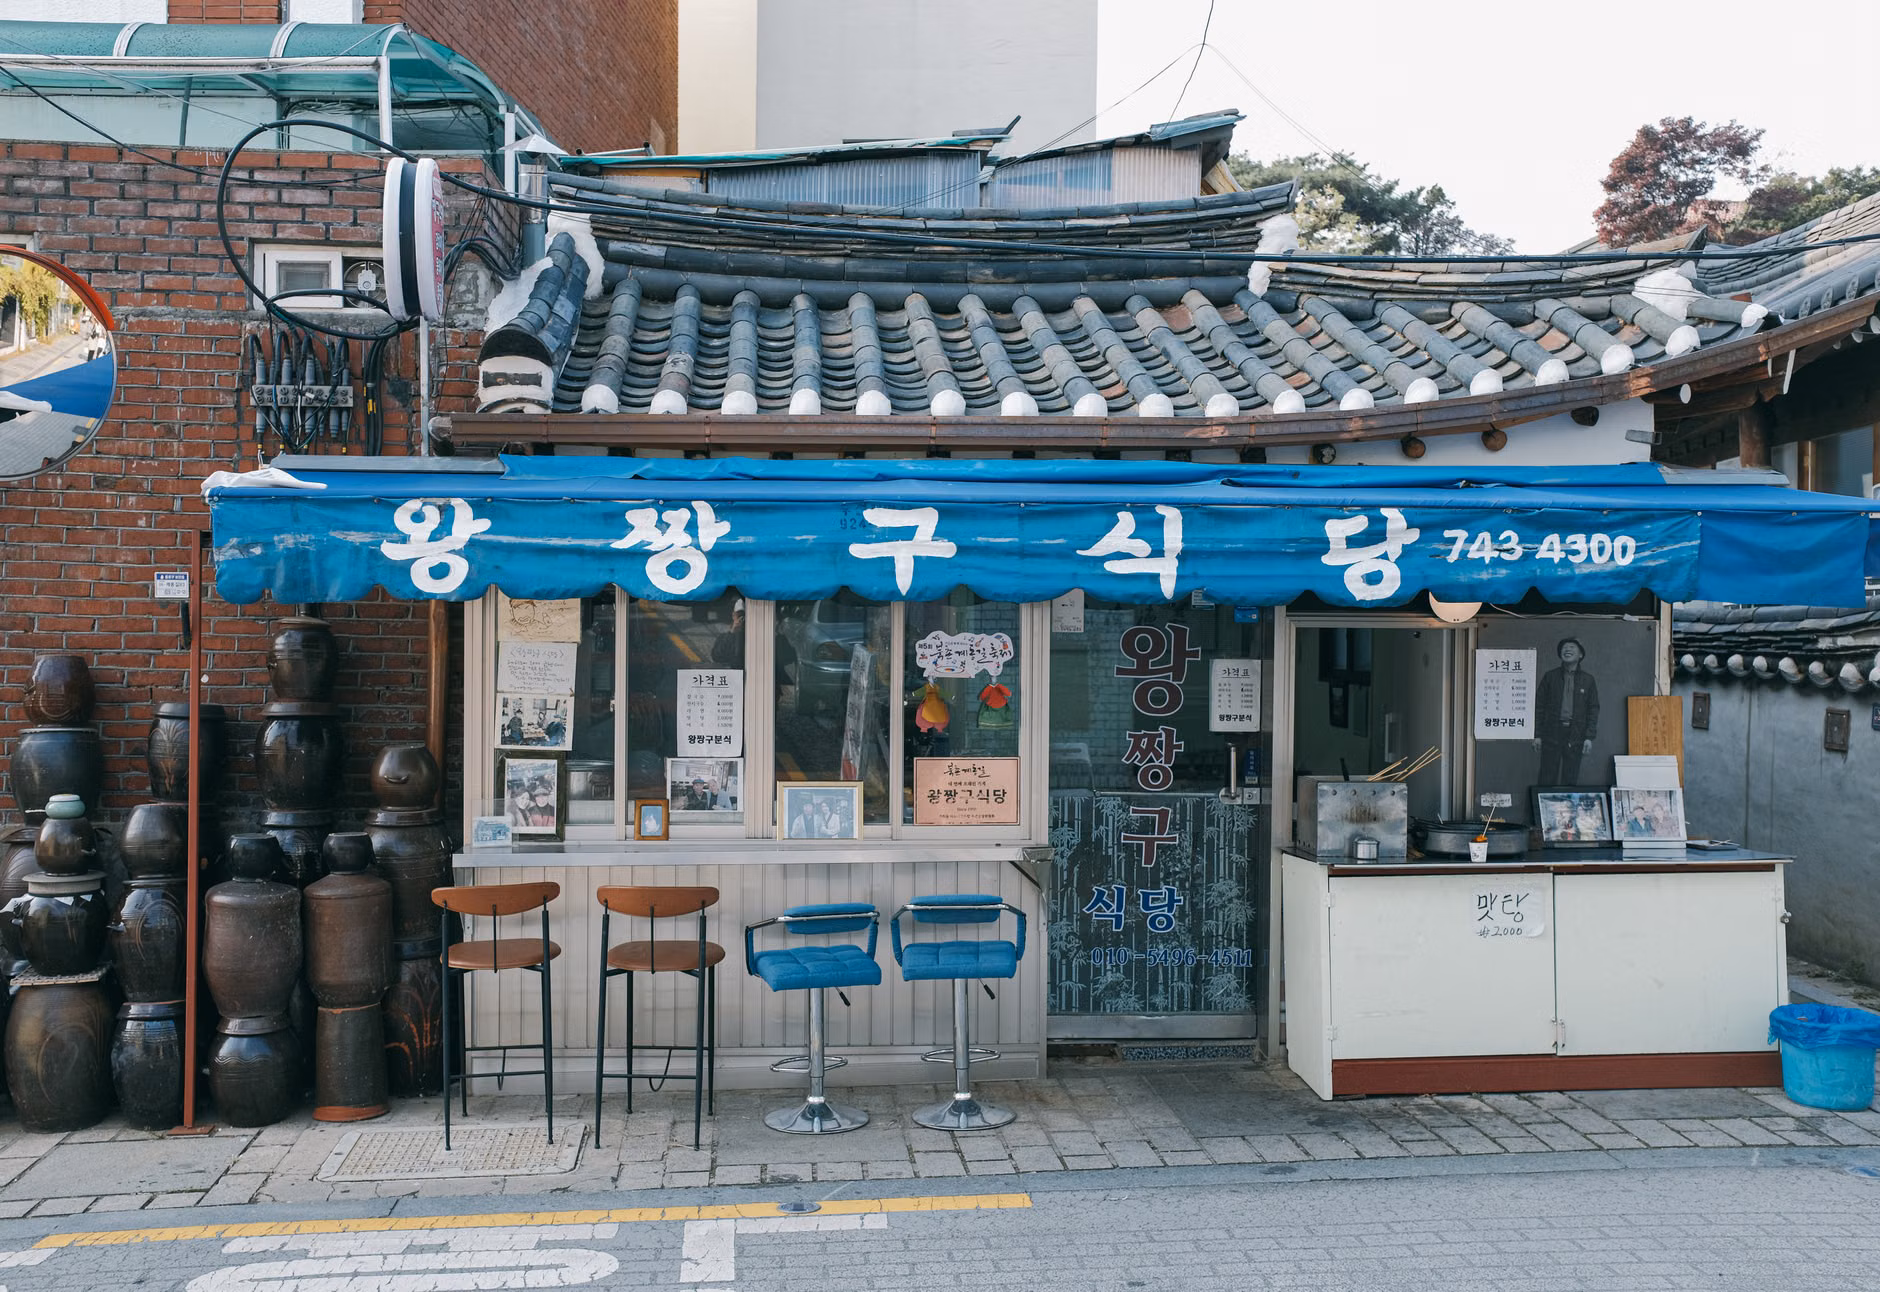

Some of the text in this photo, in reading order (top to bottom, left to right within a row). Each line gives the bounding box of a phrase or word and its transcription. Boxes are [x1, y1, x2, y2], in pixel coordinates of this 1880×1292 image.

[1443, 529, 1523, 564] 743
[1535, 533, 1636, 566] 4300
[1222, 667, 1251, 677] 가격표
[1489, 659, 1523, 672] 가격표
[692, 674, 729, 687] 가격표
[687, 734, 732, 745] 왕짱구분식
[1083, 884, 1184, 933] 식당
[1477, 891, 1530, 923] 맛탕
